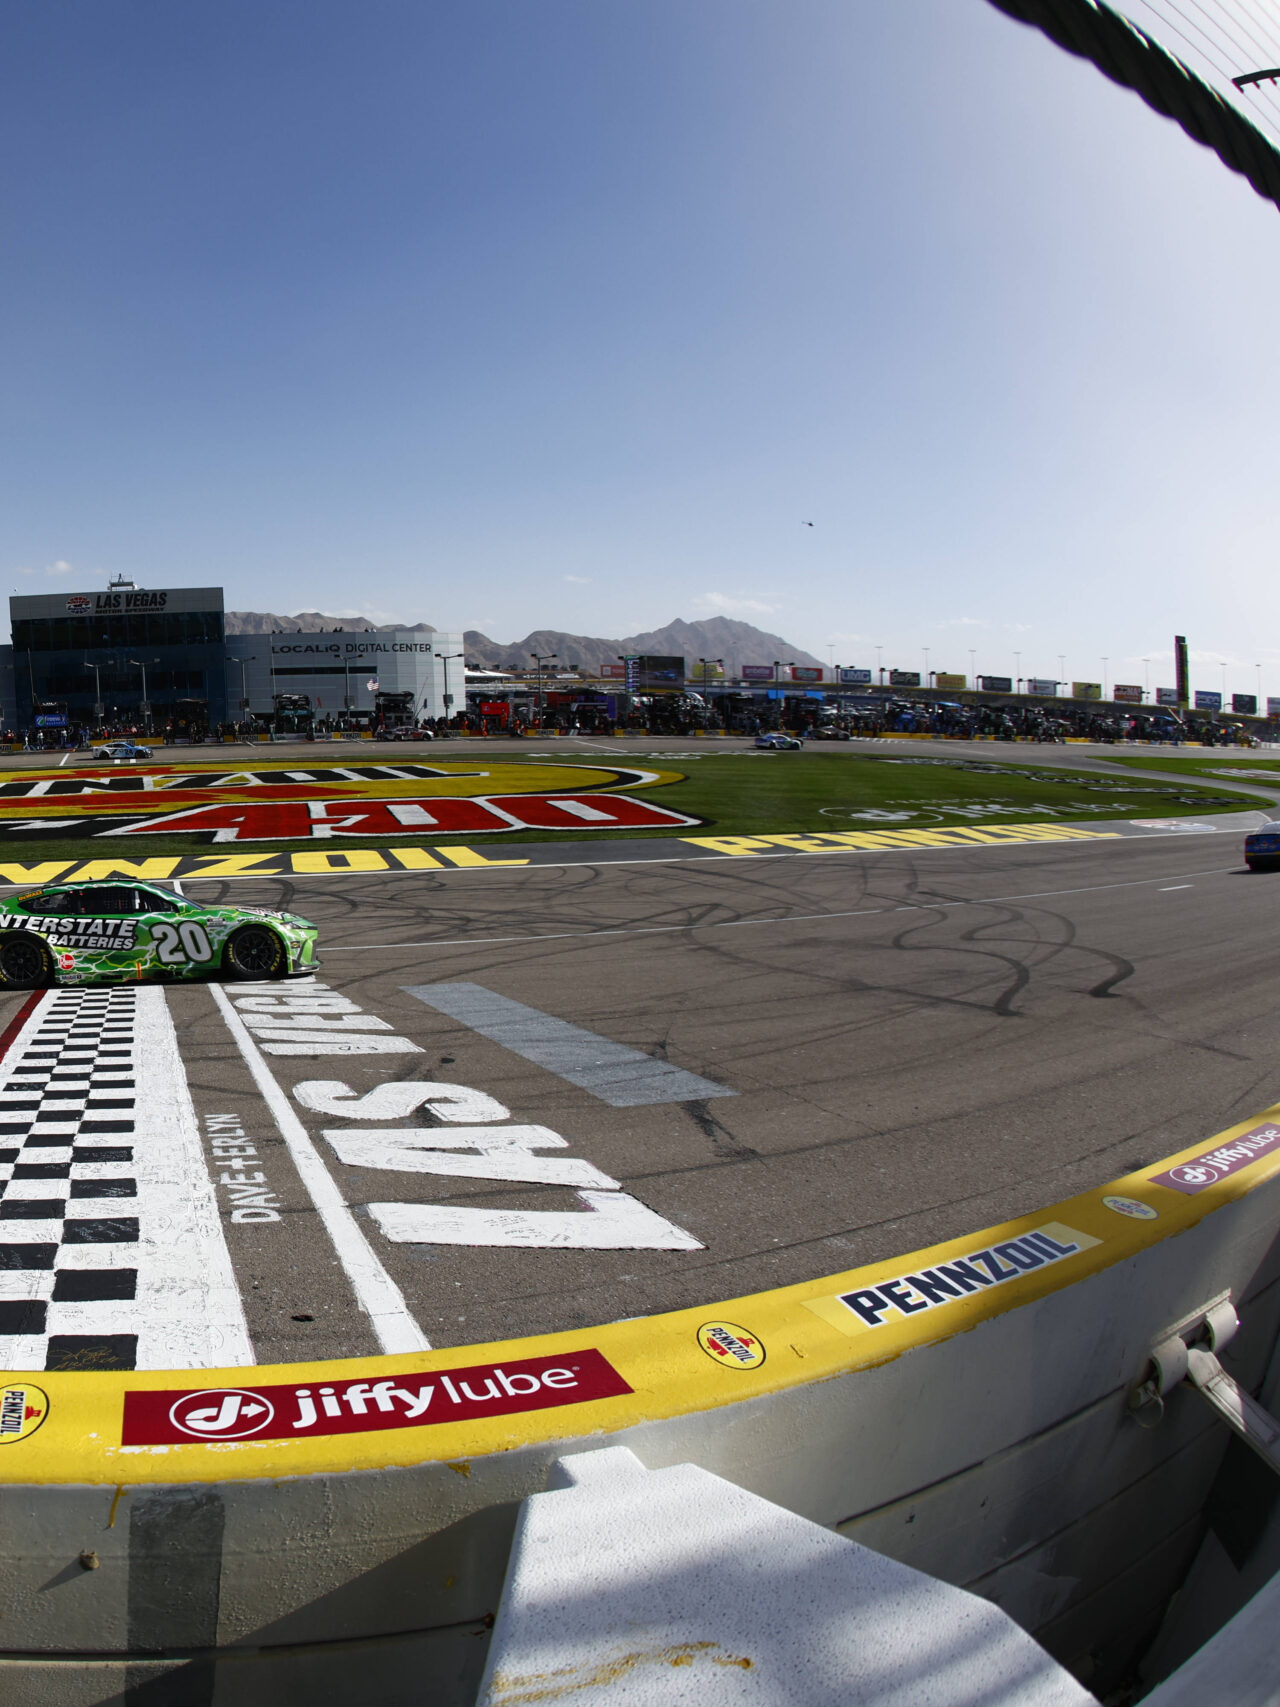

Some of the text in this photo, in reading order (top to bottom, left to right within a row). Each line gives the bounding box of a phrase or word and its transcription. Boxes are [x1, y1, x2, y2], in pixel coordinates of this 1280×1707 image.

[95, 594, 122, 609] LAS
[125, 592, 167, 608] VEGAS
[345, 643, 389, 653] DIGITAL
[392, 643, 432, 653] CENTER
[93, 793, 705, 844] 400
[676, 823, 1123, 856] PENNZOIL
[47, 934, 134, 949] BATTERIES
[150, 921, 213, 963] 20
[293, 1081, 708, 1250] LAS
[1201, 1127, 1280, 1171] jiffy lube
[840, 1231, 1080, 1327] PENNZOIL
[705, 1325, 757, 1365] PENNZOIL
[292, 1367, 576, 1429] jiffy lube
